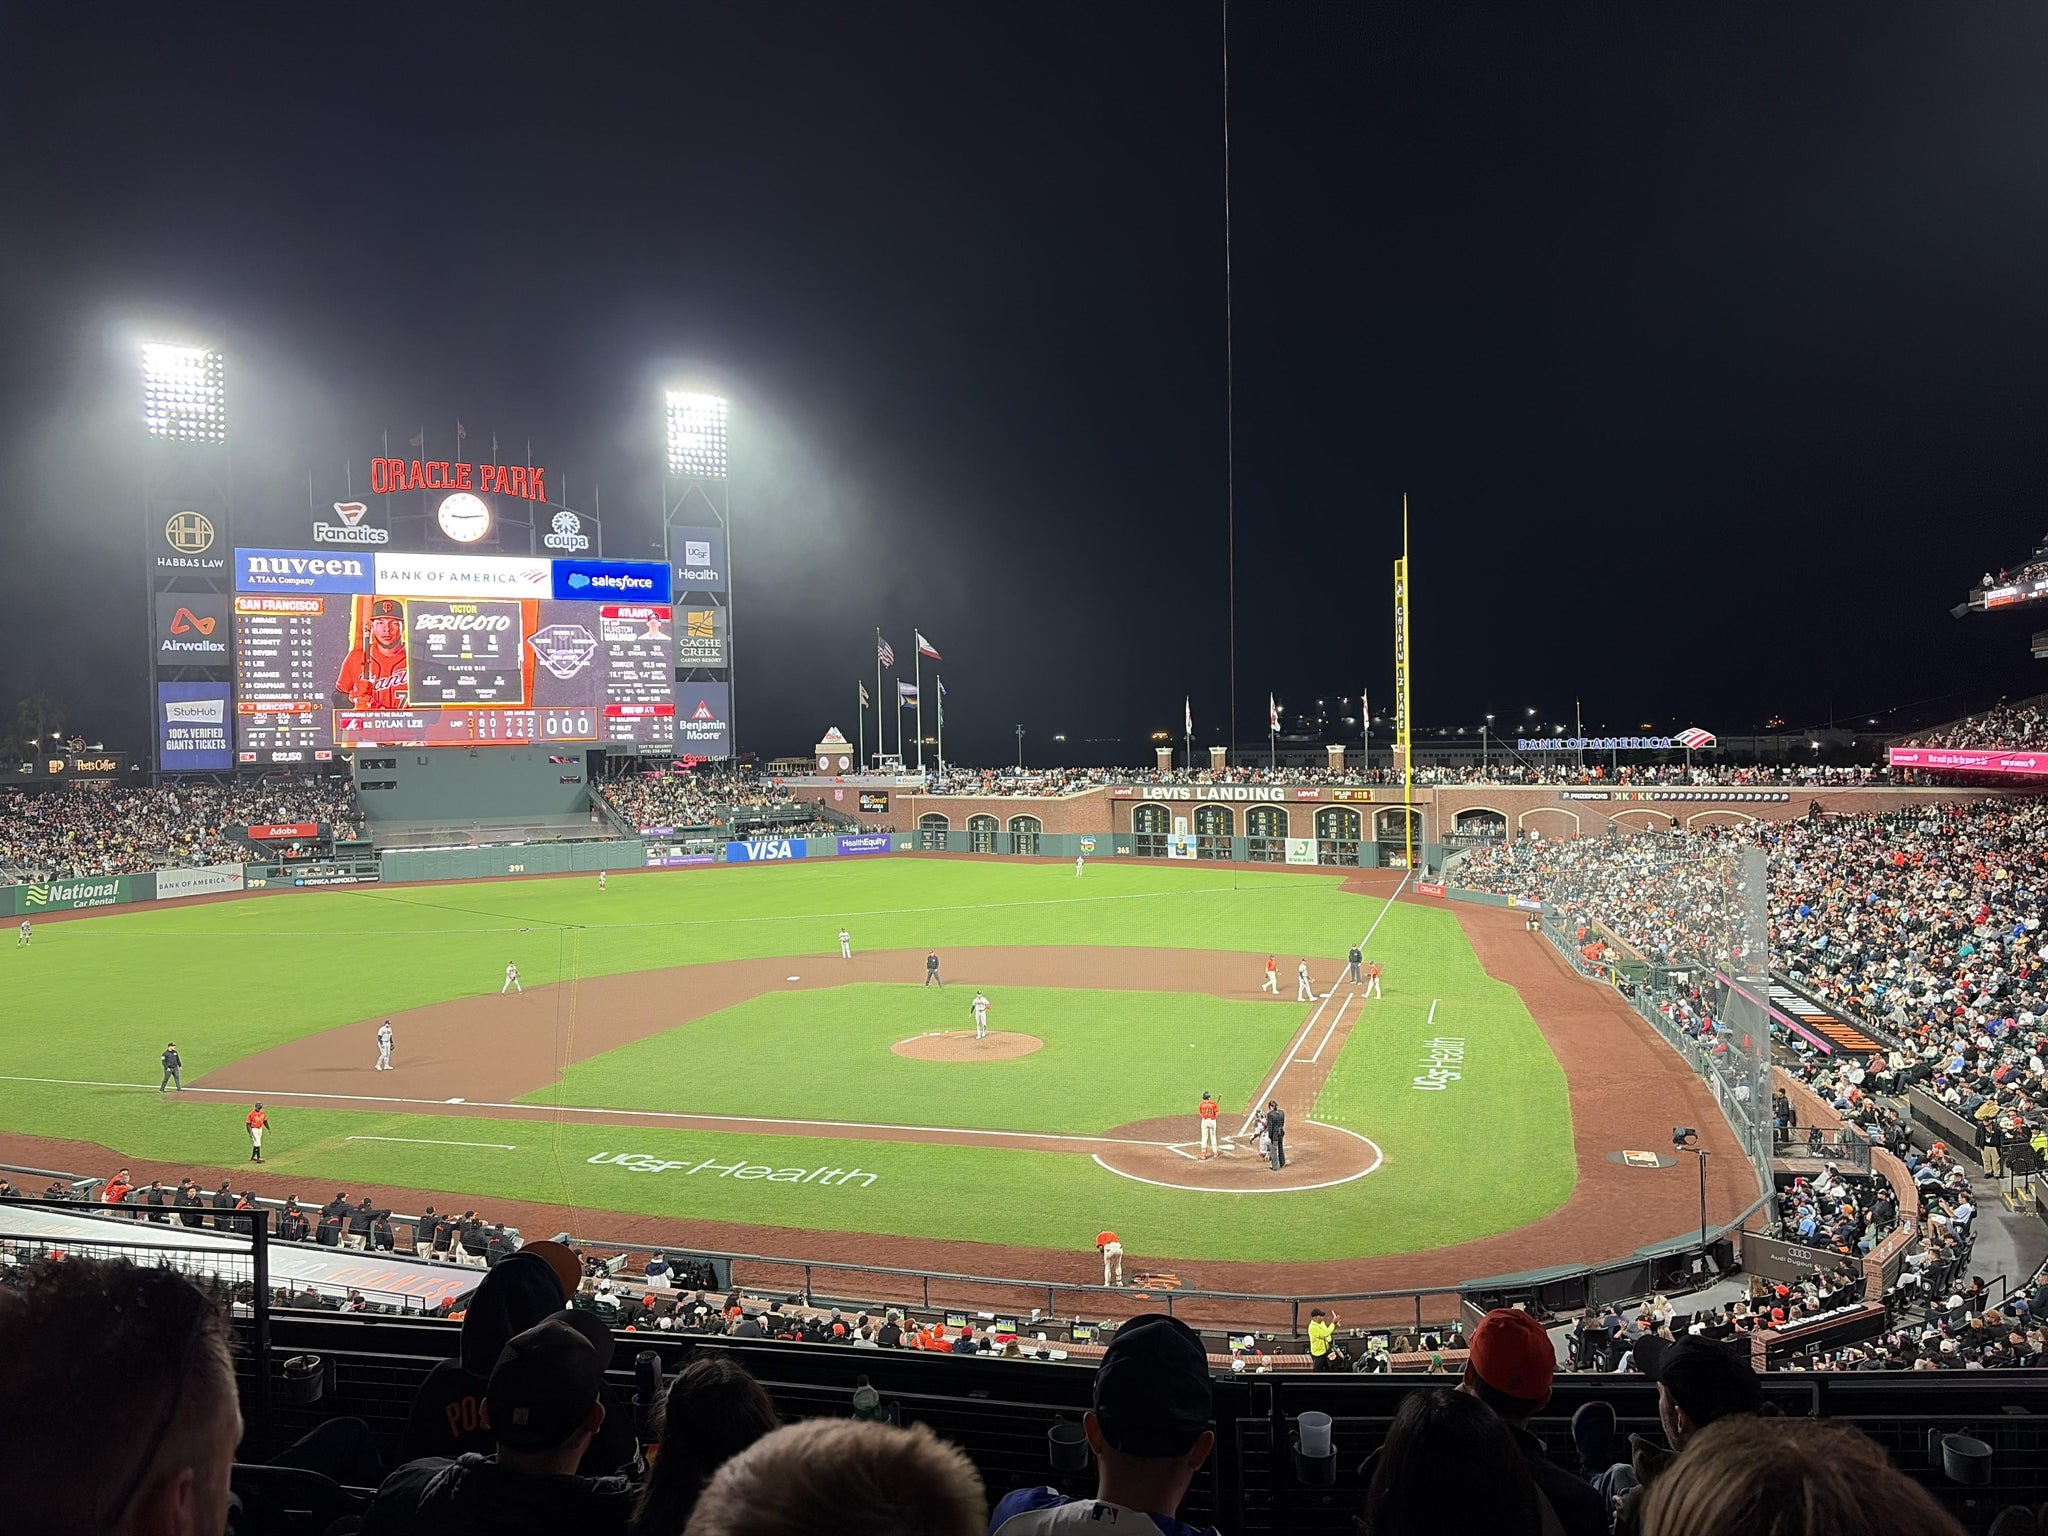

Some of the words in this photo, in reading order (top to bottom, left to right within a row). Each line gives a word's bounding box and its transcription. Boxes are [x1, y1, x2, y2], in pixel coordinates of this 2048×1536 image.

[370, 457, 473, 493] ORACLE
[480, 464, 548, 503] PARK
[315, 524, 387, 543] Fanatics
[546, 533, 588, 551] coupa
[688, 548, 707, 559] UCSF
[157, 557, 199, 568] HABBAS
[201, 559, 224, 568] LAW
[248, 556, 363, 576] nuveen
[380, 570, 421, 581] BANK
[427, 571, 444, 581] OF
[449, 572, 517, 583] AMERICA
[679, 568, 719, 580] Health
[256, 576, 277, 584] TIAA
[278, 577, 315, 586] Company
[591, 575, 653, 590] salesforce
[240, 599, 261, 610] SAN
[262, 601, 319, 611] FRANCISCO
[450, 604, 477, 613] VICTOR
[415, 614, 510, 631] BERICOTO
[162, 640, 225, 651] Airwallex
[680, 638, 721, 648] CACHE
[682, 648, 720, 656] CREEK
[174, 707, 216, 717] StubHub
[375, 720, 403, 728] DYLAN
[407, 720, 423, 728] LEE
[467, 718, 474, 727] 3
[479, 718, 485, 727] 8
[490, 718, 496, 727] 0
[506, 718, 512, 727] 7
[517, 718, 523, 727] 3
[528, 718, 534, 727] 2
[547, 718, 557, 734] 0
[562, 718, 572, 734] 0
[578, 718, 588, 734] 0
[680, 720, 726, 731] Benjamin
[168, 728, 189, 739] 100%
[190, 728, 223, 739] VERIFIED
[469, 728, 473, 738] 1
[479, 728, 485, 738] 5
[491, 728, 495, 738] 1
[506, 728, 512, 738] 6
[516, 728, 523, 738] 4
[528, 728, 534, 737] 2
[687, 731, 719, 740] Moore
[166, 740, 194, 750] GIANTS
[195, 739, 226, 751] TICKETS
[1517, 738, 1562, 750] BANK
[1567, 738, 1589, 749] OF
[1592, 737, 1671, 749] AMERICA
[272, 752, 302, 762] $22,150
[683, 753, 707, 762] Coors
[77, 759, 95, 771] Peet's
[95, 759, 116, 772] Coffee
[1196, 787, 1285, 800] LANDING
[1570, 792, 1609, 800] PRIZEPICKS
[868, 795, 887, 804] Sports
[842, 838, 887, 848] HealthEquity
[742, 841, 792, 859] VISA
[1390, 858, 1407, 866] 309
[509, 864, 524, 872] 391
[159, 882, 179, 890] BANK
[192, 877, 226, 886] AMERICA
[248, 879, 266, 888] 399
[305, 878, 328, 886] KONICA
[49, 880, 119, 901] National
[1420, 886, 1441, 894] ORACLE
[73, 900, 88, 909] Car
[89, 897, 116, 906] Rental
[1203, 1107, 1212, 1115] 78
[587, 1152, 690, 1173] UCSF
[685, 1159, 878, 1187] Health
[1770, 1254, 1786, 1262] Audi
[1787, 1257, 1813, 1269] Dugout
[322, 1267, 464, 1301] GIANTS
[1798, 1310, 1839, 1323] Dugout
[1837, 1303, 1862, 1312] Club
[444, 1396, 478, 1437] PO
